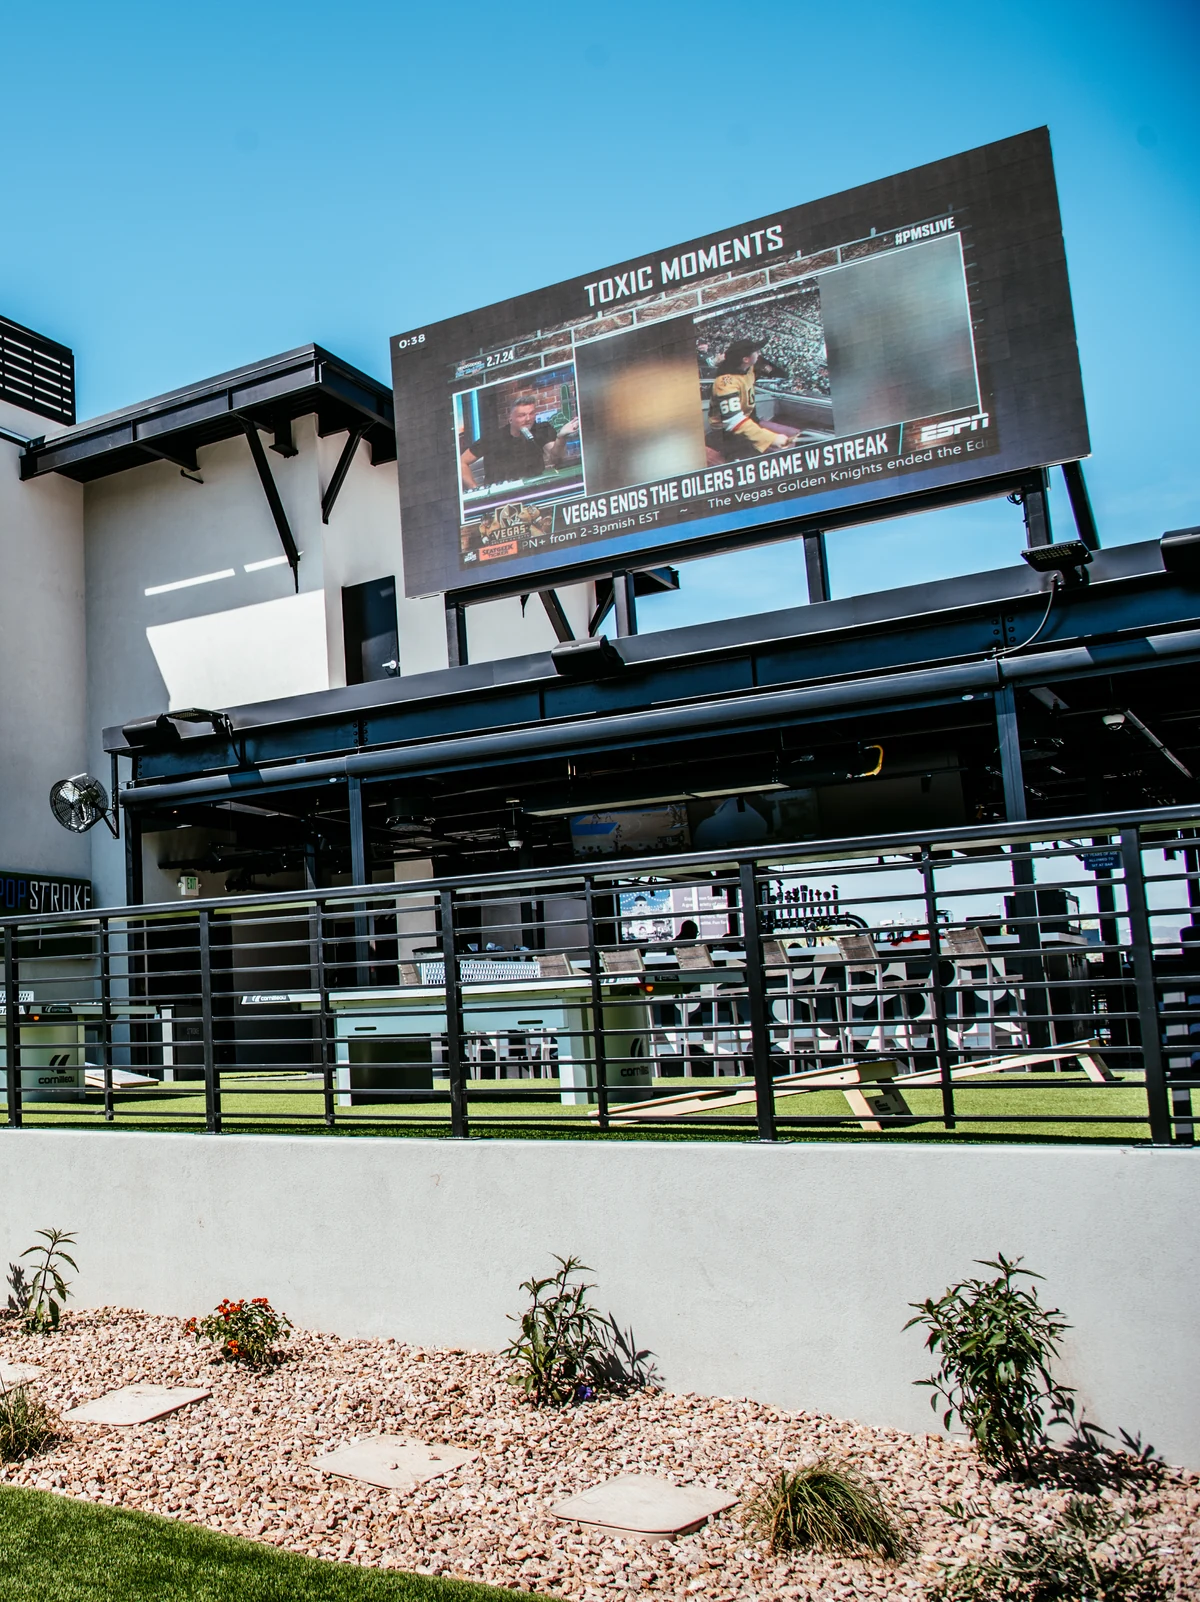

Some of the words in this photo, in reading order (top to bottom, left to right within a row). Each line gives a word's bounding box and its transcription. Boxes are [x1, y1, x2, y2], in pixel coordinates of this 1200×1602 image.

[895, 216, 955, 246] #PMSLIVE
[584, 266, 653, 307] TOXIC
[660, 225, 784, 284] MOMENTS
[398, 334, 426, 349] 0:38
[486, 350, 514, 367] 2.7.24
[920, 412, 989, 443] ESPN
[562, 498, 607, 525] VEGAS
[610, 488, 648, 515] ENDS
[650, 482, 679, 505] THE
[681, 468, 734, 499] OILERS
[736, 464, 756, 487] 16
[759, 453, 803, 481] GAME
[805, 448, 820, 470] W
[823, 432, 888, 469] STREAK
[708, 496, 732, 508] The
[734, 488, 774, 505] Vegas
[777, 475, 826, 494] Golden
[830, 462, 883, 482] Knights
[887, 450, 933, 469] ended
[937, 445, 962, 459] the
[493, 524, 526, 540] VEGAS
[550, 530, 577, 544] from
[580, 516, 635, 538] 2-3pmish
[639, 511, 660, 525] EST
